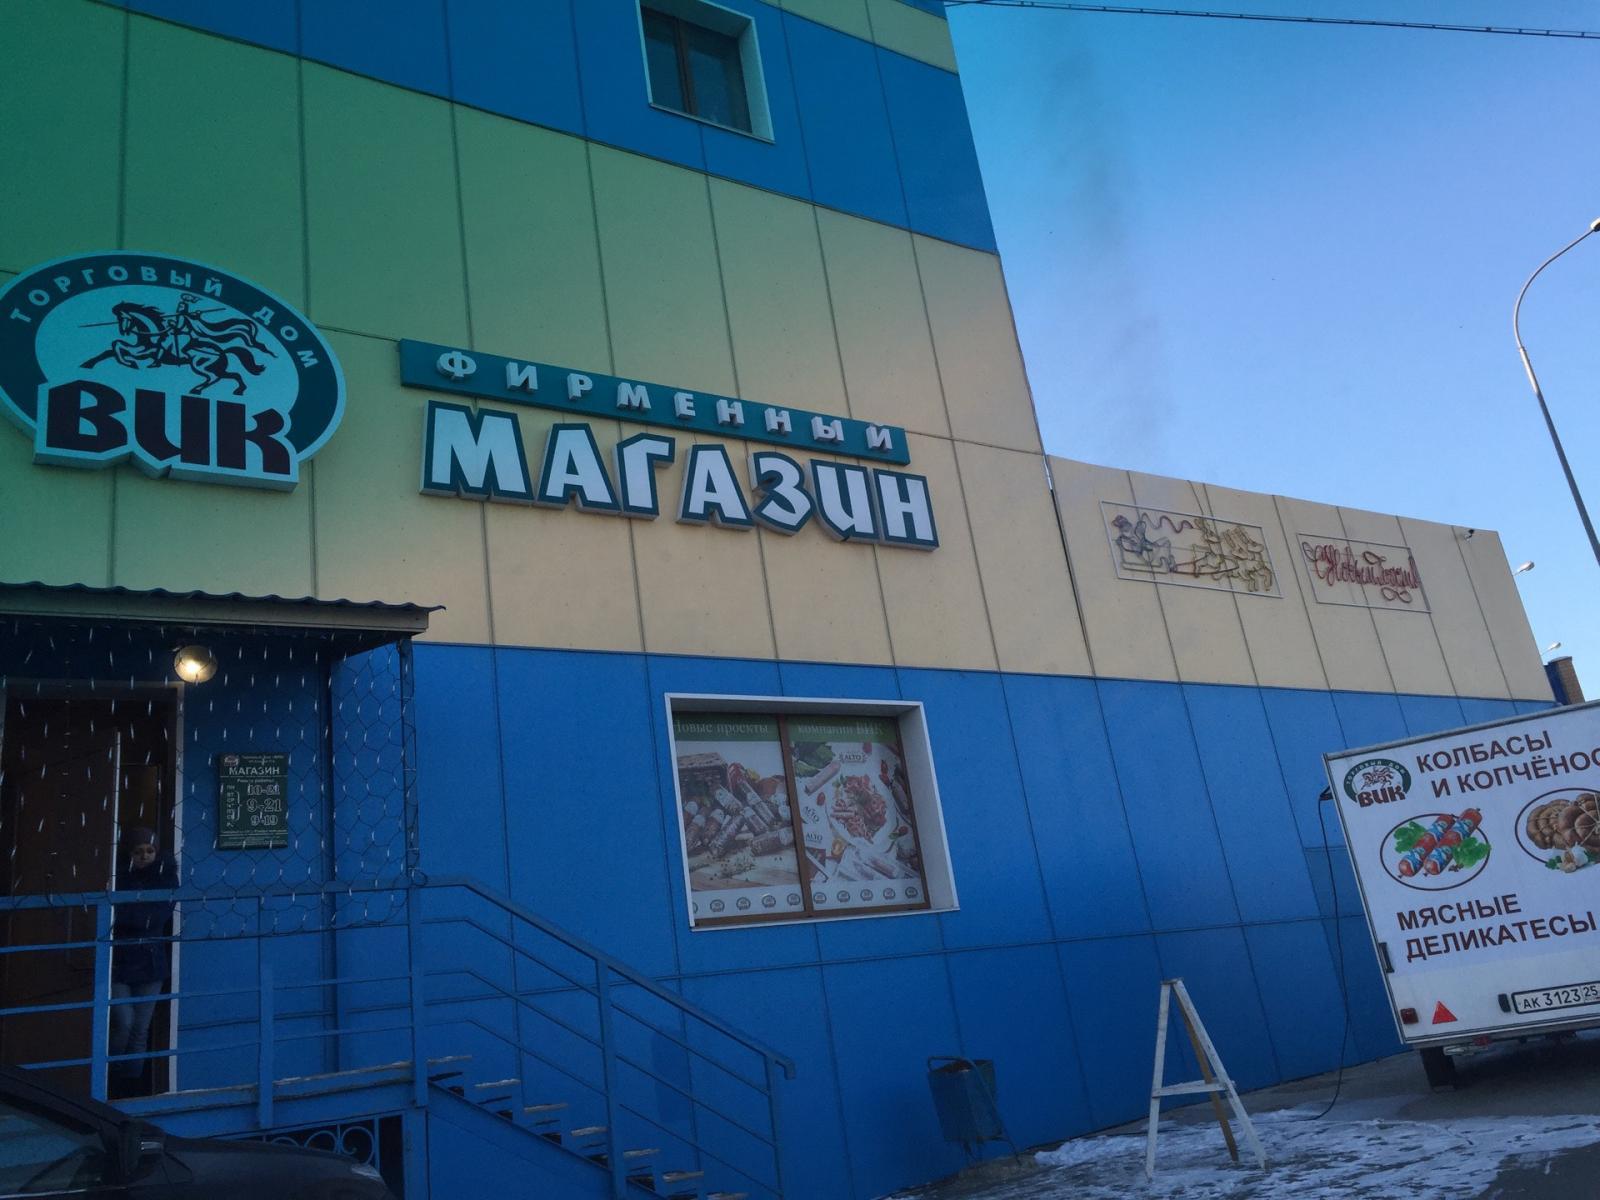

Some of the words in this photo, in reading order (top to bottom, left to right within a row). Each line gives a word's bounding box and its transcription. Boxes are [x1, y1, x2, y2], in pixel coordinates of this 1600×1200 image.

[9, 265, 223, 323] ТОРГОВЫЙ
[253, 305, 319, 368] ДОМ
[437, 351, 893, 452] ФИРМЕННЫЙ
[46, 380, 291, 475] ВИК
[424, 401, 938, 550] МАГАЗИН
[716, 723, 769, 737] проекты
[229, 766, 281, 776] МАГАЗИН
[1416, 730, 1553, 774] КОЛБАСЫ
[246, 797, 282, 812] 9-21
[1358, 785, 1406, 808] ВИК
[1431, 778, 1451, 798] И
[1396, 893, 1522, 931] МЯСНЫЕ
[1406, 911, 1598, 963] ДЕЛИКАТЕСЫ
[1583, 985, 1598, 997] 25
